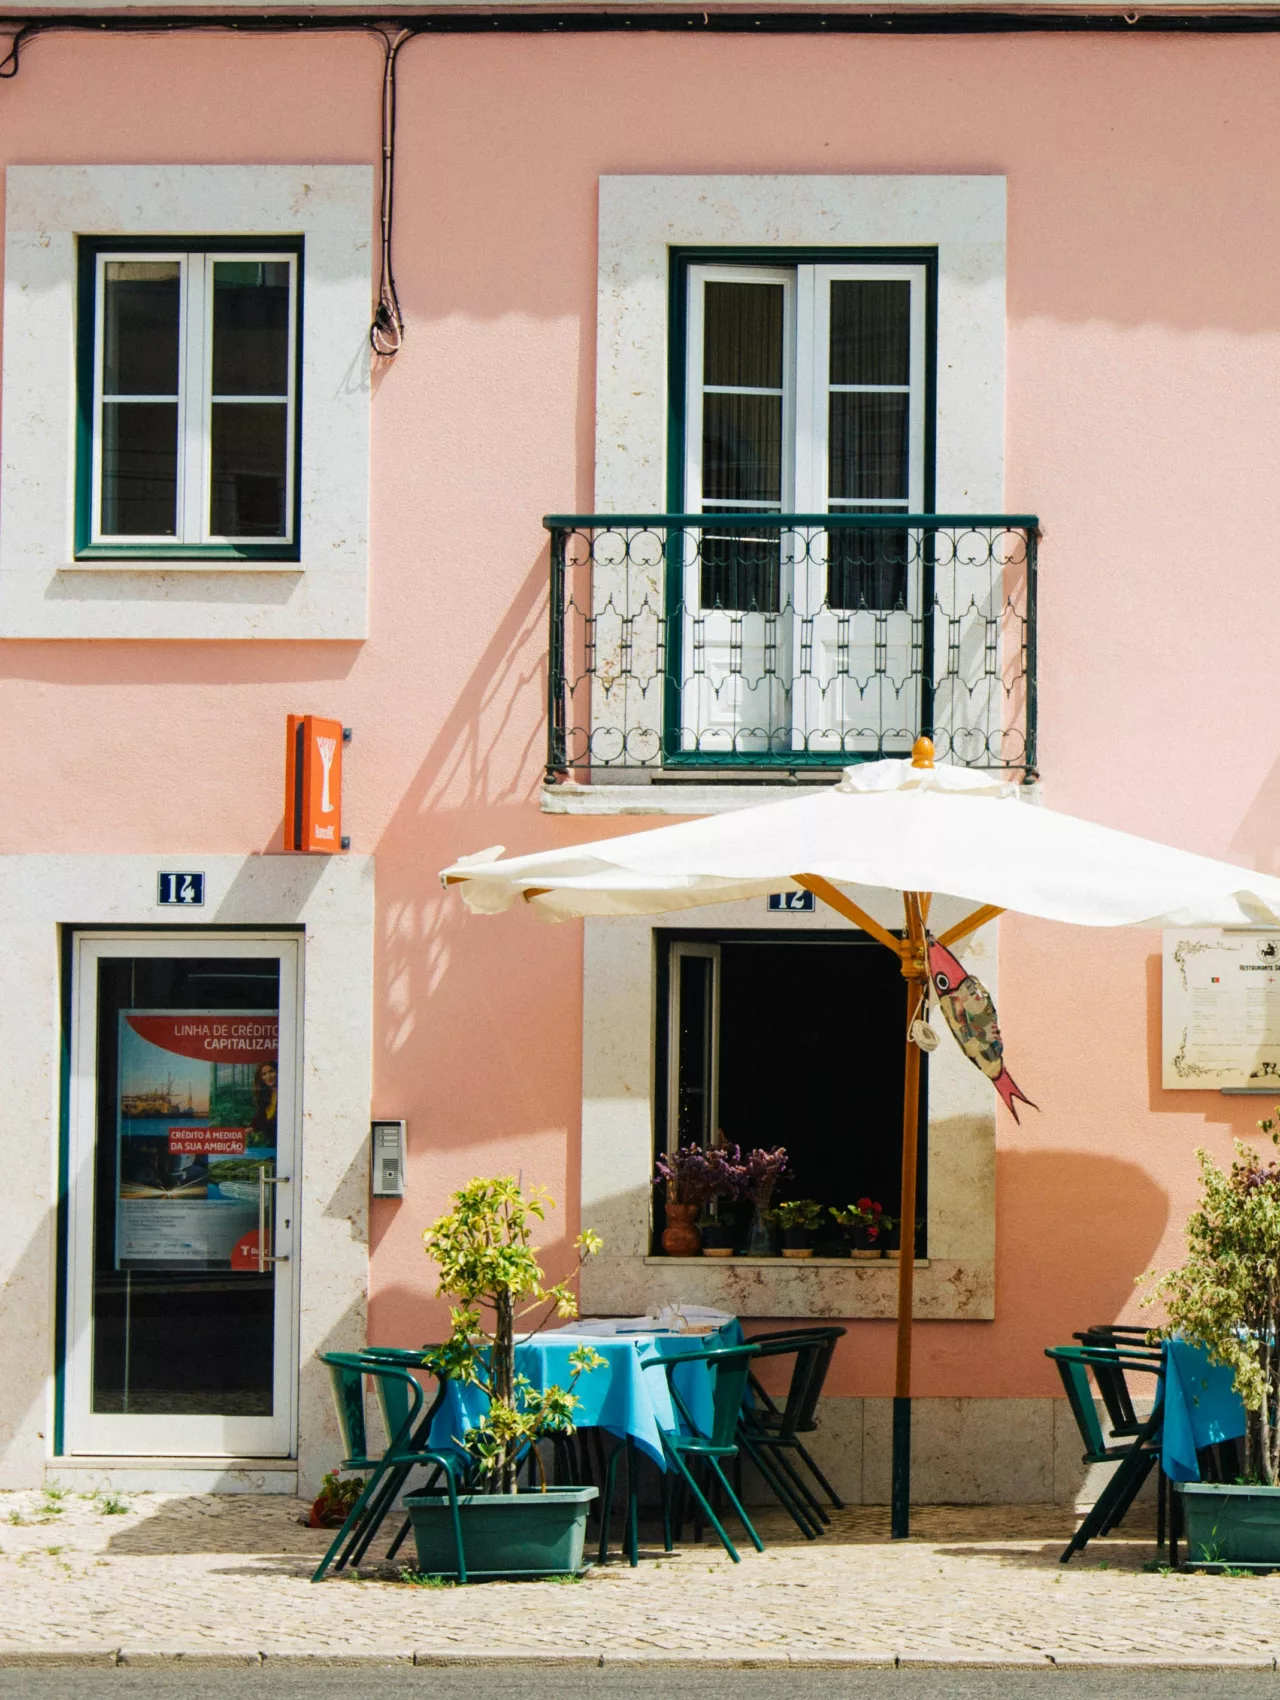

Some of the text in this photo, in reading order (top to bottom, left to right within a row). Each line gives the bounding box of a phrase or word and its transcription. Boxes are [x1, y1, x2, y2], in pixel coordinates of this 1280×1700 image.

[167, 874, 195, 903] 14
[778, 889, 806, 909] 12
[174, 1024, 209, 1036] LINHA
[212, 1024, 228, 1036] DE
[171, 1130, 204, 1139] CRÉDITO
[213, 1131, 243, 1139] MEDIDA
[171, 1140, 243, 1152] DA SUA AMBIÇÃO
